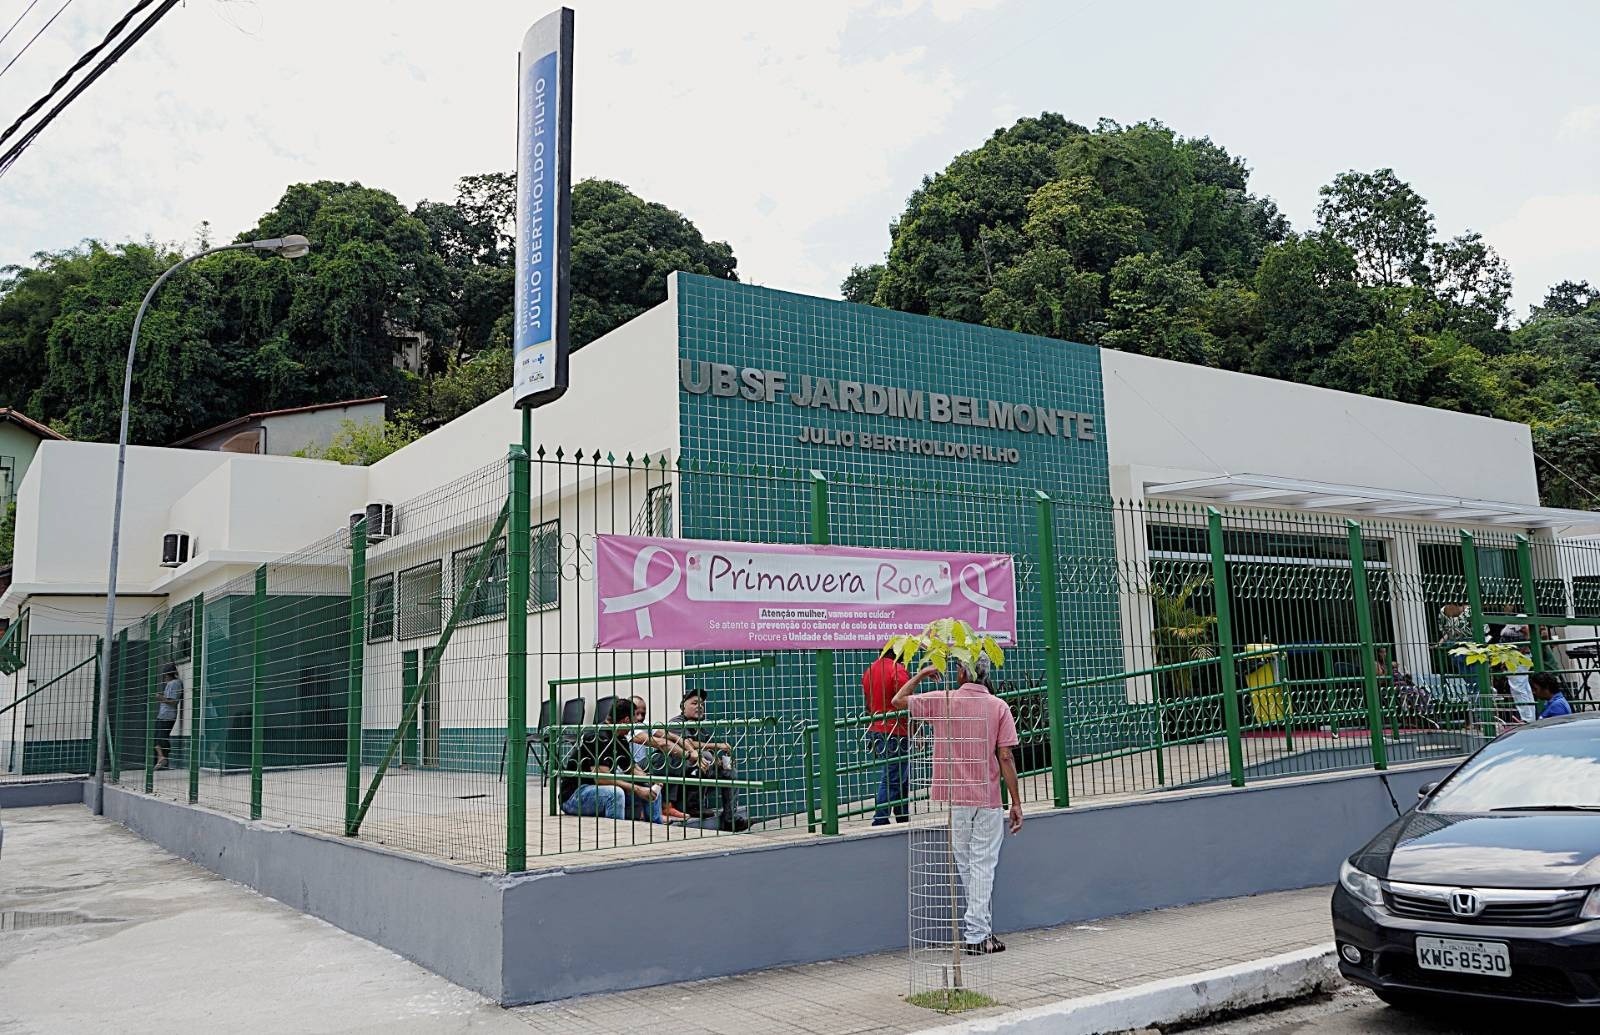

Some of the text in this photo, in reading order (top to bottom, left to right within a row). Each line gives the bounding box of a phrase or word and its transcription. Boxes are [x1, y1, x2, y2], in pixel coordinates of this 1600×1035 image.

[528, 77, 546, 329] JÚLIO BERTHOLDO FILHO
[680, 358, 1095, 441] UBSF JARDIM BELMONTE
[797, 426, 1020, 464] JULIO BERTHOLDO FILHO
[708, 554, 939, 600] Primavera Rosa
[709, 620, 721, 630] Se
[721, 620, 749, 630] atente
[757, 620, 800, 632] prevenção
[801, 621, 812, 630] do
[813, 620, 840, 630] câncer
[841, 621, 851, 630] de
[851, 621, 868, 630] colo
[761, 609, 796, 620] Atenção
[797, 609, 827, 619] mulher,
[869, 610, 896, 619] cuidar?
[749, 631, 781, 641] Procure
[788, 631, 822, 641] Unidade
[823, 631, 833, 641] de
[833, 631, 857, 641] Saúde
[858, 632, 876, 641] mais
